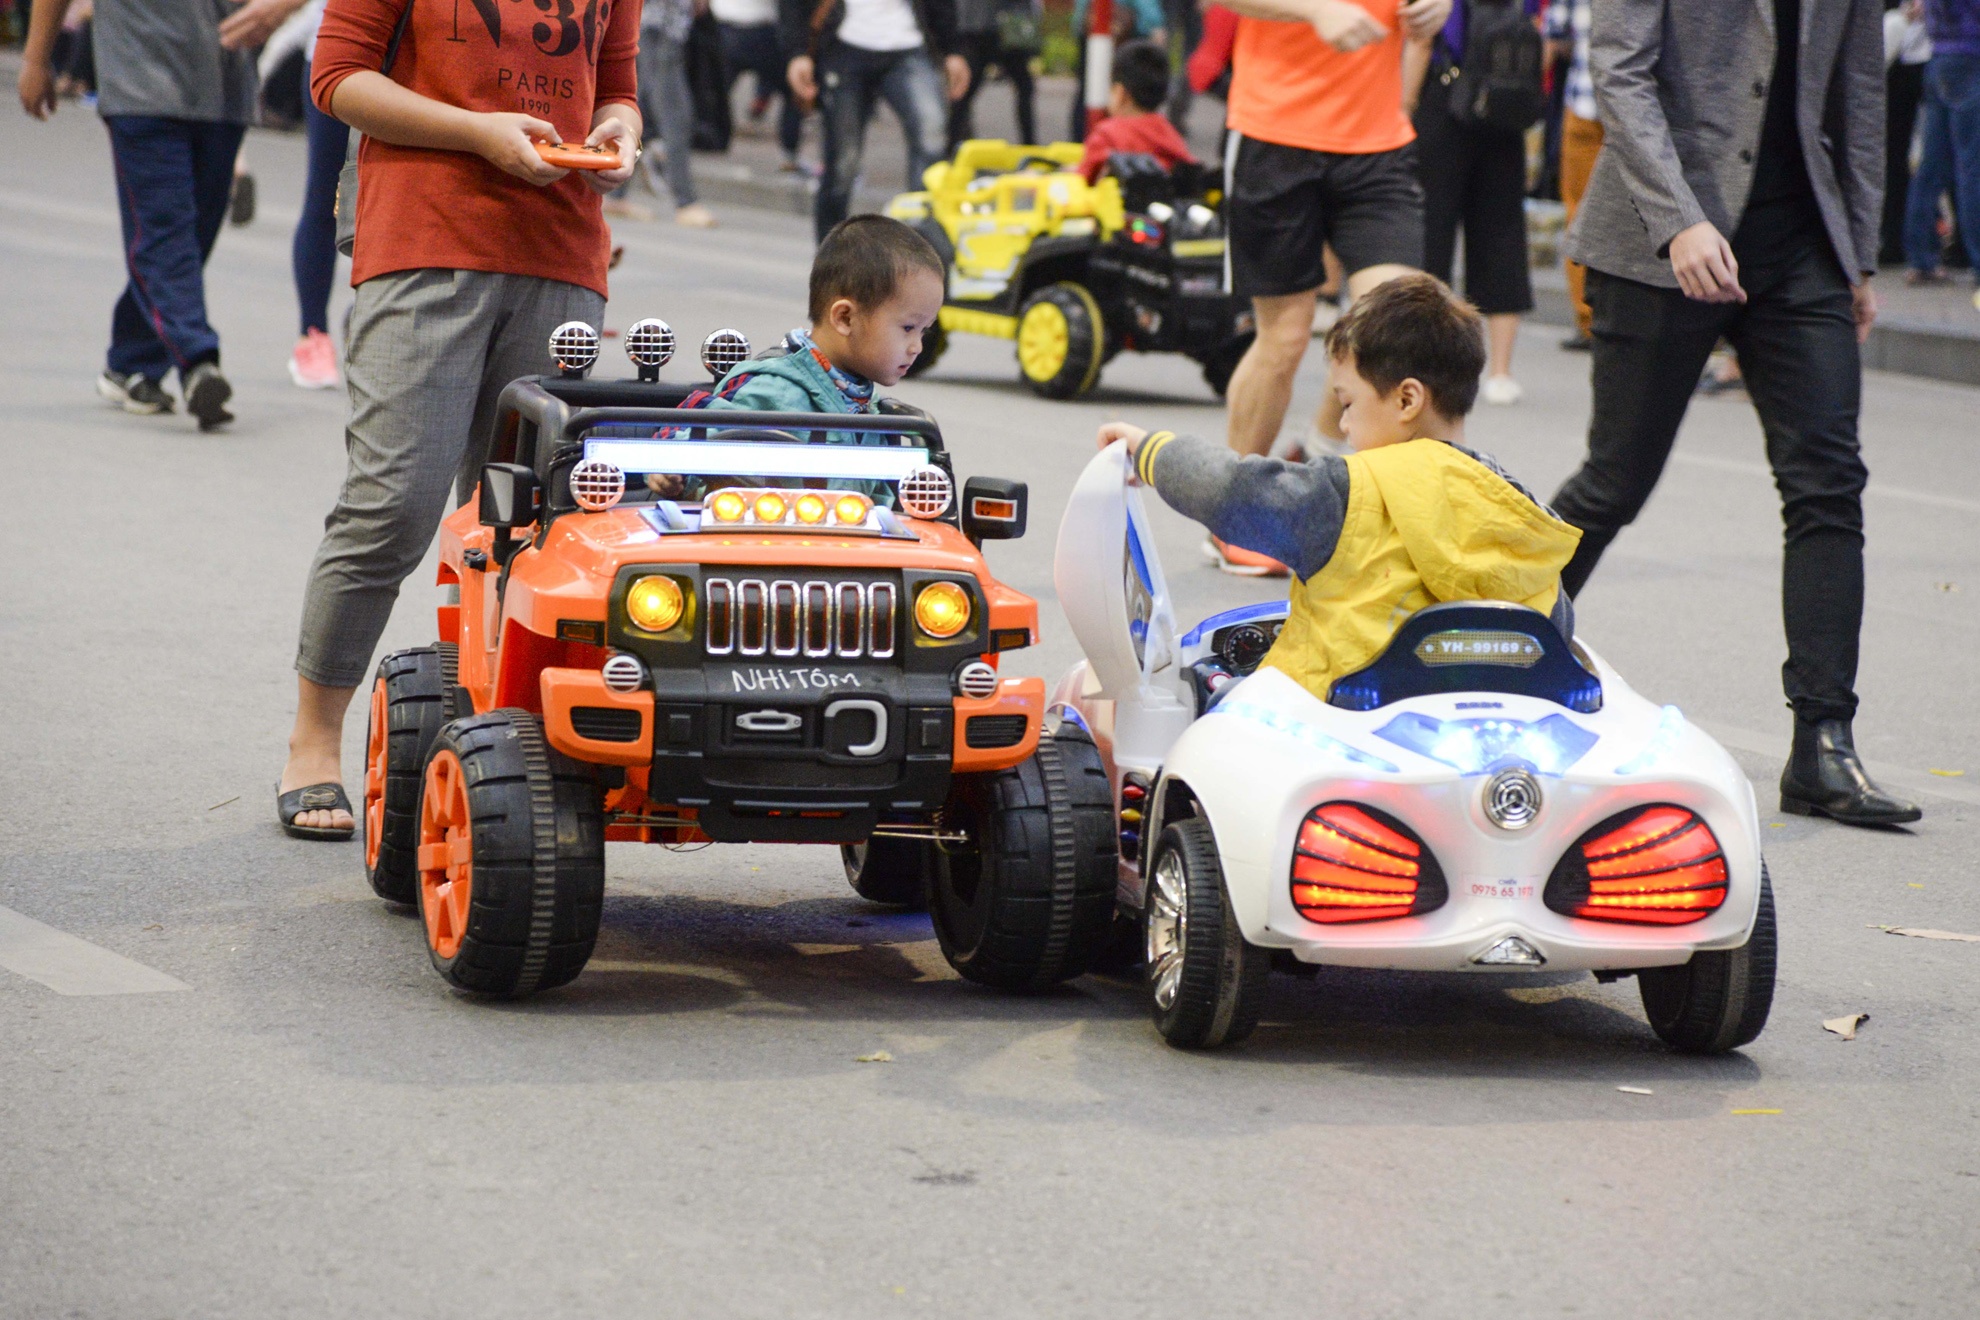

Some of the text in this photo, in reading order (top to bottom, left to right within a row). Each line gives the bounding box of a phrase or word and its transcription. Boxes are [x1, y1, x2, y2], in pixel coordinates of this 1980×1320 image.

[497, 68, 574, 99] PARIS
[520, 97, 550, 115] 1990
[1471, 884, 1497, 896] 0975
[1501, 886, 1515, 897] 65
